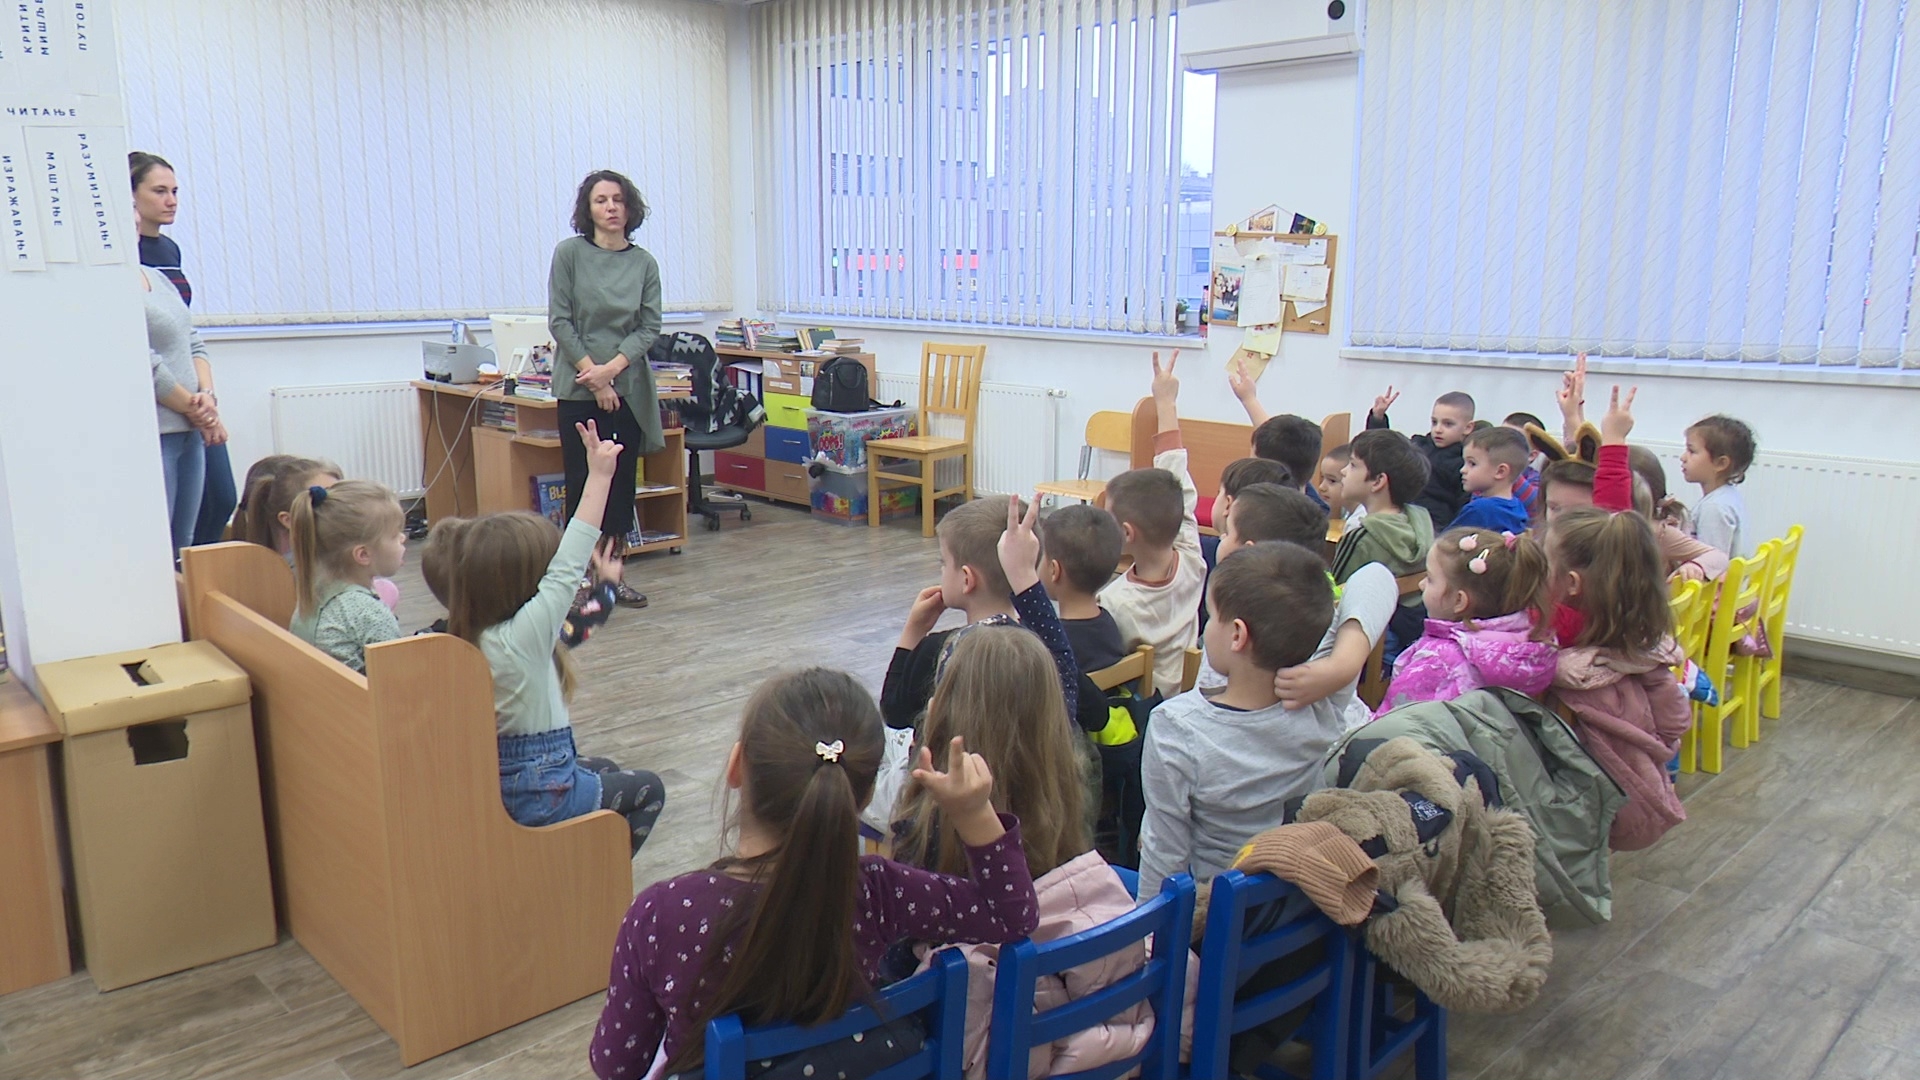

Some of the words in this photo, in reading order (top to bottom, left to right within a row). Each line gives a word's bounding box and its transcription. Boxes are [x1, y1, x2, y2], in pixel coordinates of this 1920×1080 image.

[75, 3, 87, 51] ПУТОВ
[6, 107, 76, 117] ЧИТАЊЕ
[2, 155, 28, 260] ИЗРАЖАВАЊЕ
[45, 151, 63, 226] МАШТАЊЕ
[77, 133, 112, 250] РАЗУМИЈЕВАЊЕ
